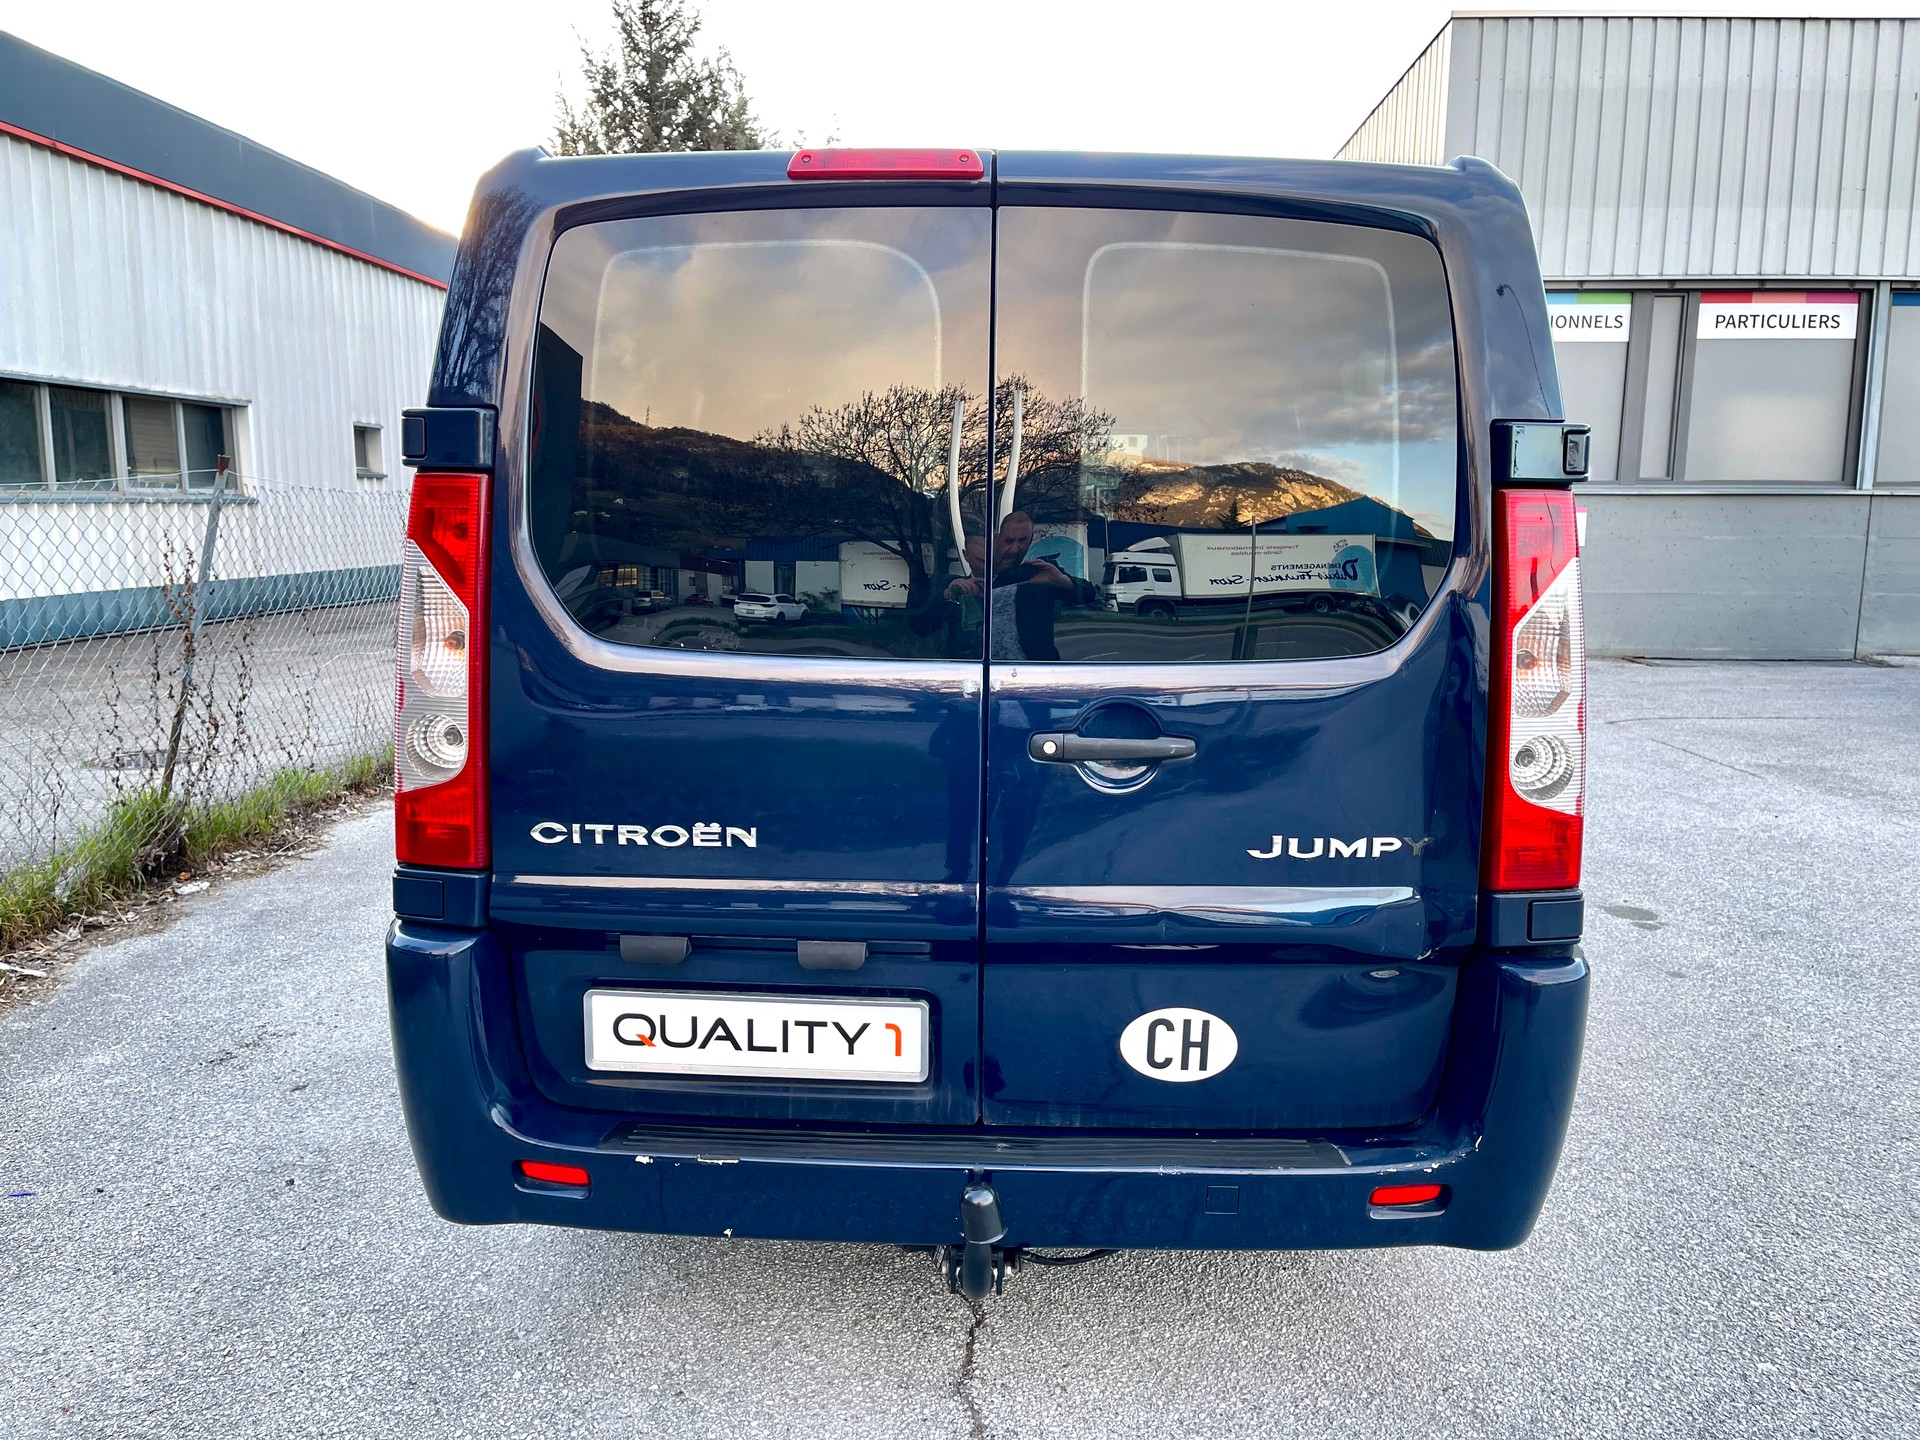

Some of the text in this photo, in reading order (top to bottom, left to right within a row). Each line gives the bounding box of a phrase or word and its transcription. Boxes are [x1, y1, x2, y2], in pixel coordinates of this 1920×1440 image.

[1550, 315, 1623, 328] IONNELS
[1715, 314, 1841, 329] PARTICULIERS
[530, 822, 757, 848] CITROËN
[1246, 835, 1434, 860] JUMPY
[613, 1013, 902, 1057] QUALITY 1
[1146, 1018, 1210, 1071] CH
